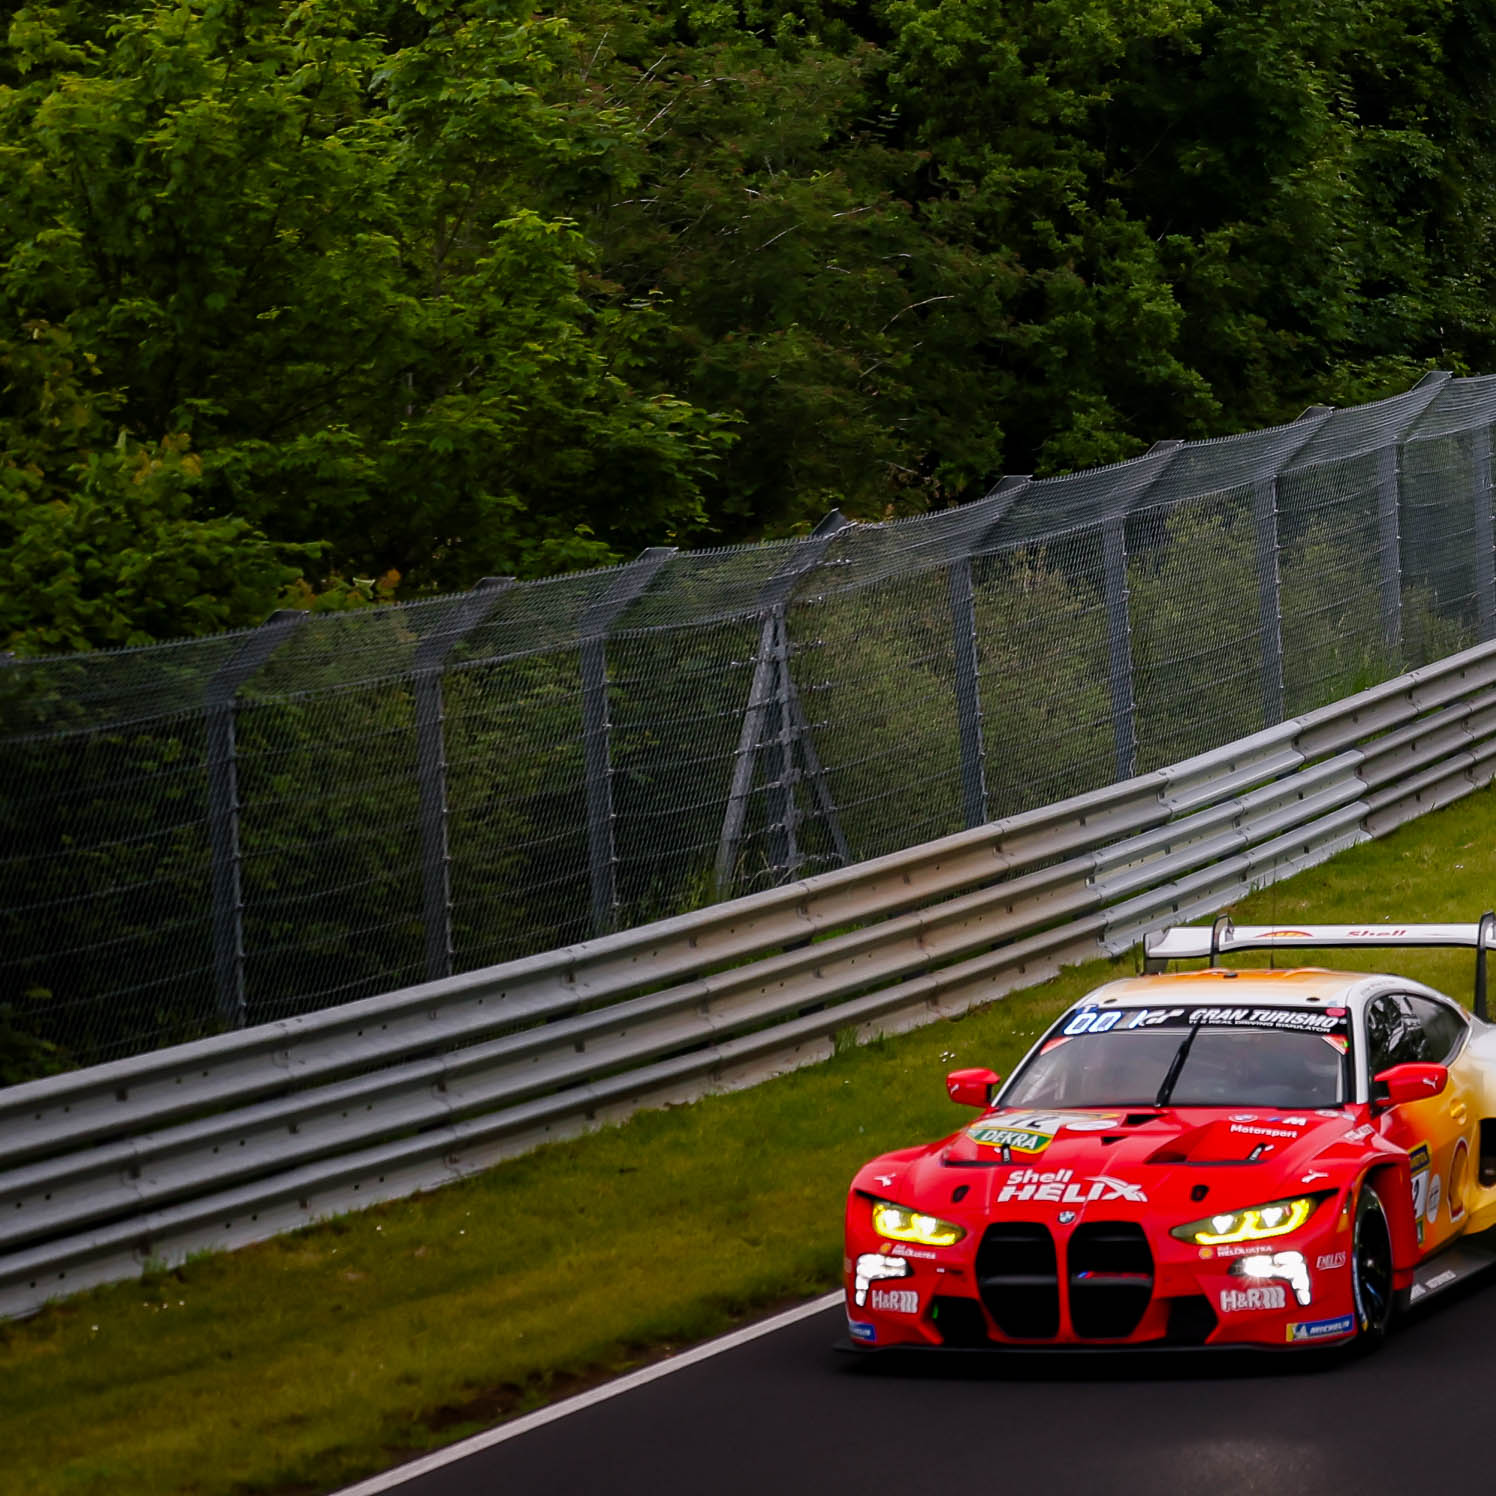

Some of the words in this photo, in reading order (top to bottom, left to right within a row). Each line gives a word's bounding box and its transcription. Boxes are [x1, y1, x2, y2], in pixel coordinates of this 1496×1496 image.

[1345, 929, 1408, 937] Shell
[1188, 1008, 1249, 1023] GRAN
[1251, 1009, 1339, 1028] TURISMO
[981, 1130, 1039, 1149] DEKRA
[1230, 1124, 1298, 1138] Motorsport
[1007, 1168, 1073, 1184] Shell
[997, 1175, 1148, 1203] HELIX
